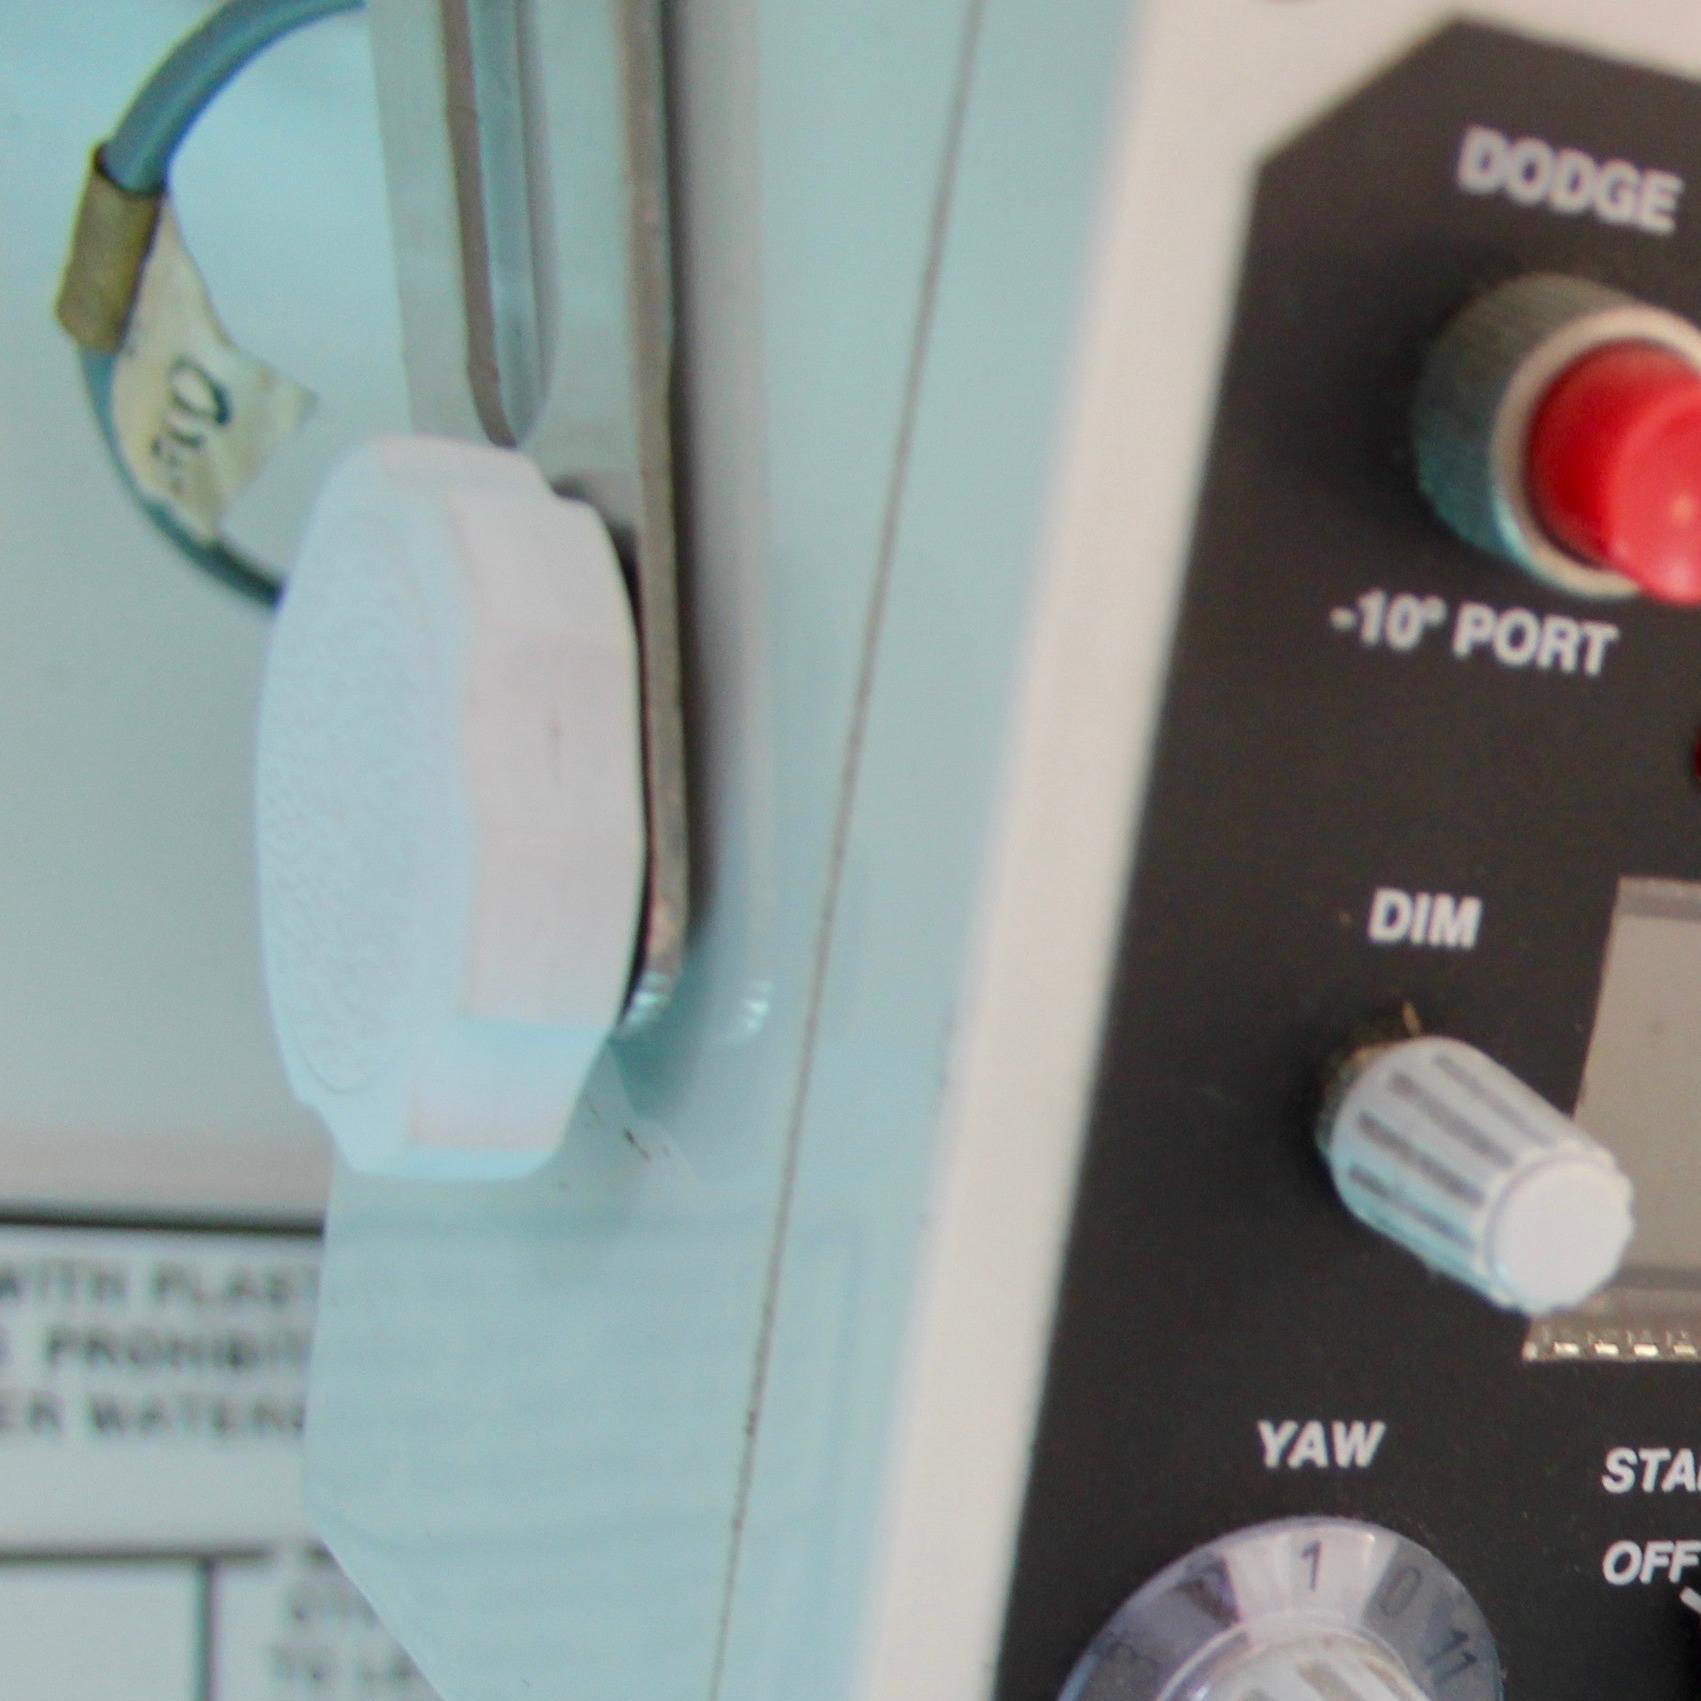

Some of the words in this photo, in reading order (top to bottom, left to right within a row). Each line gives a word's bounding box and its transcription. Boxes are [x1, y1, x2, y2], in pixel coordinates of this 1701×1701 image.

[1457, 126, 1685, 236] DODGE
[1452, 603, 1619, 676] PORT
[1368, 887, 1482, 949] DIM
[1257, 1420, 1387, 1469] YAW
[1301, 1538, 1322, 1592] 1
